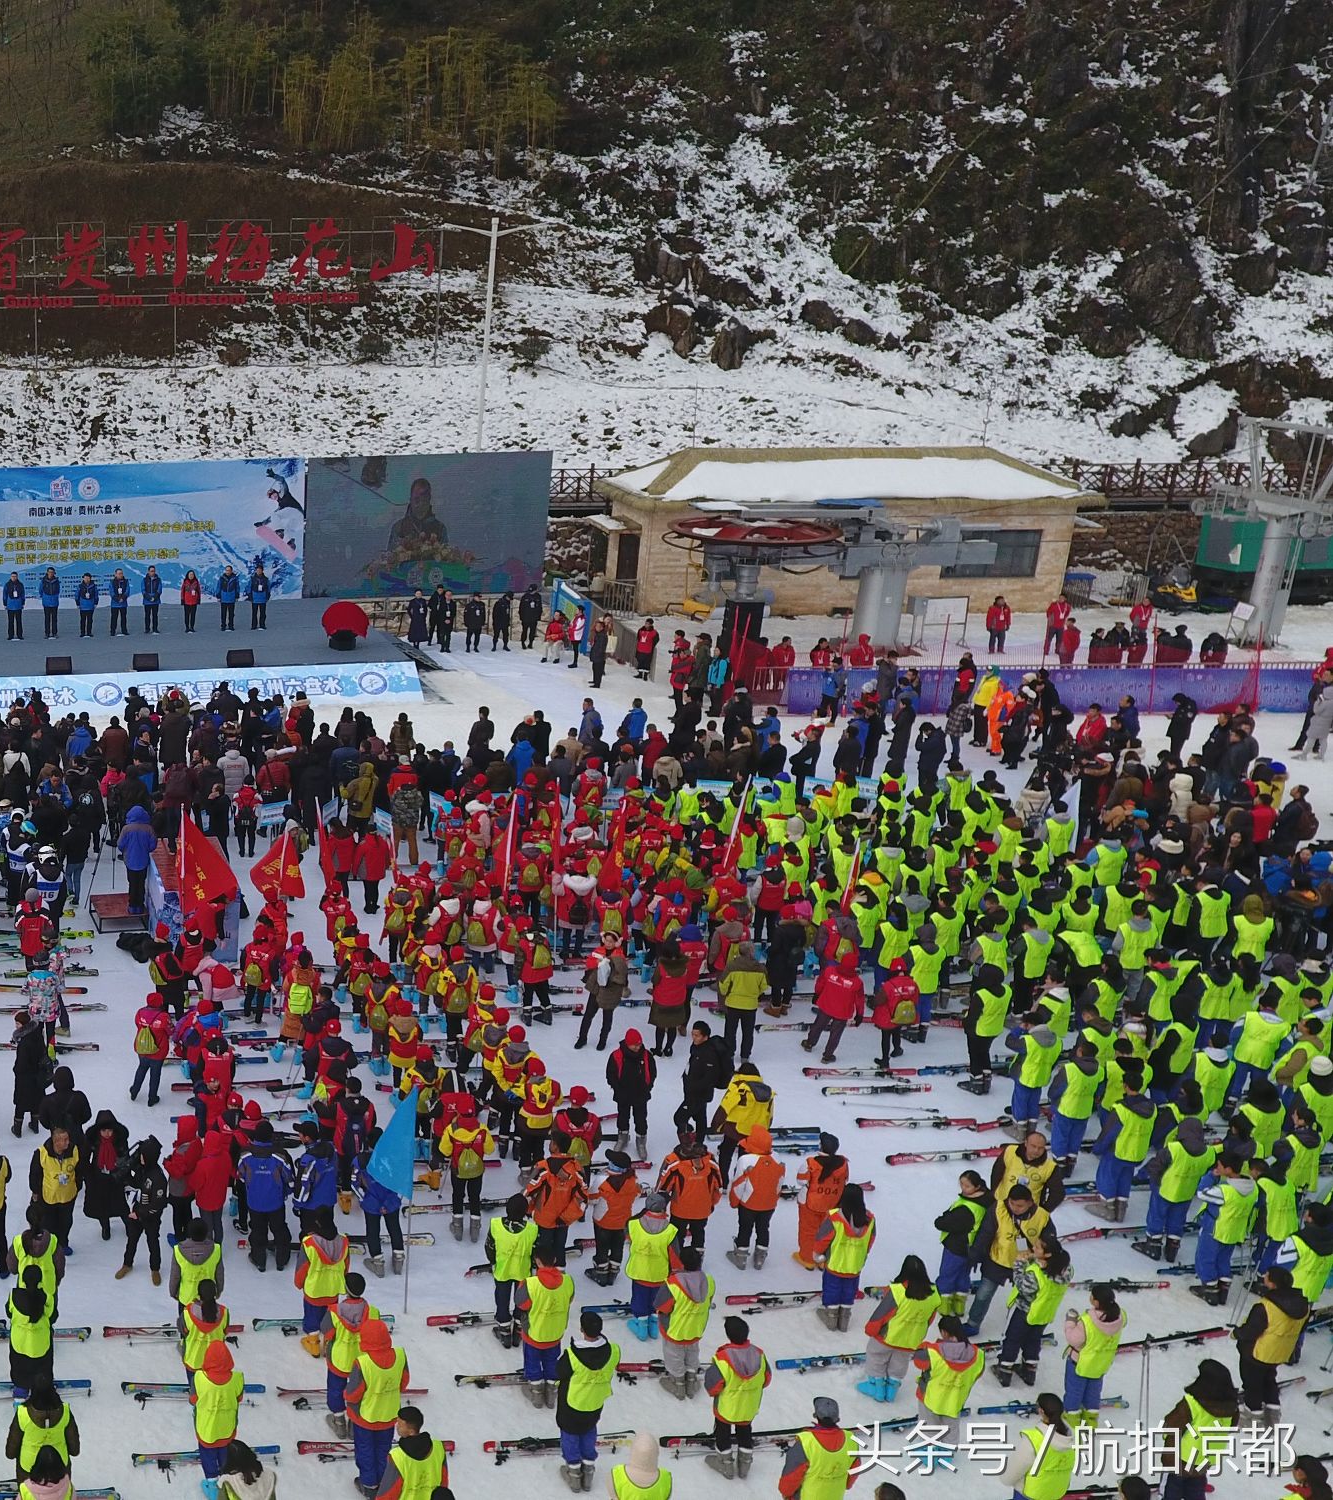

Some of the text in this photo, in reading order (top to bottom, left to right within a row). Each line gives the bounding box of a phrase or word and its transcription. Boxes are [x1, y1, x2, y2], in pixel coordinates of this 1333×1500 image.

[3, 294, 73, 308] Guizhou
[98, 293, 143, 306] Plum
[169, 291, 246, 305] Blossom
[28, 504, 123, 517] 南国冰雪城·贵州六盘水
